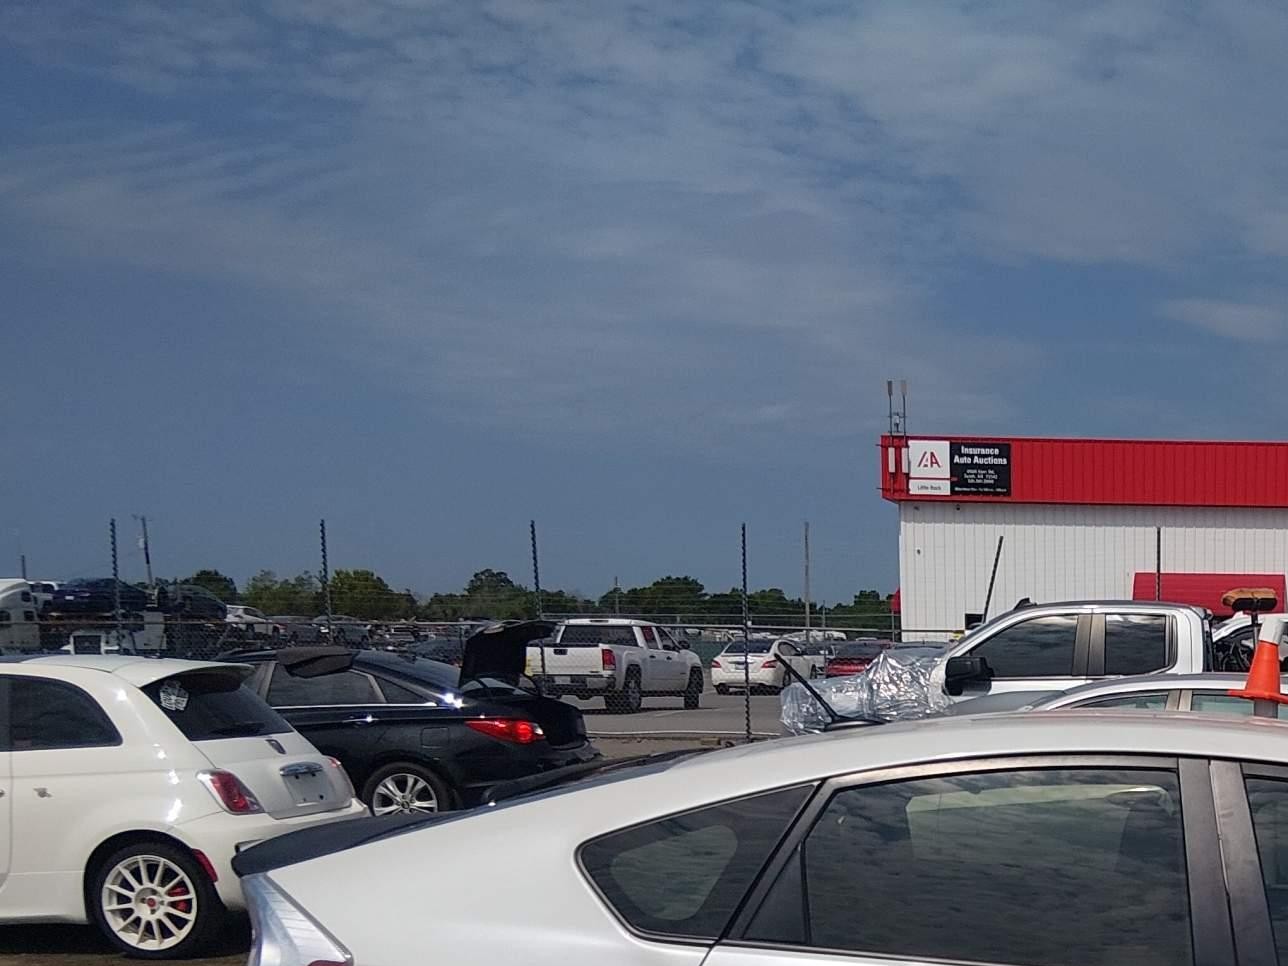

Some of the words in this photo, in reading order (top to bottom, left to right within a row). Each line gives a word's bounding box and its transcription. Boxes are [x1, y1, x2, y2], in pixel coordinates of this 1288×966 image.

[961, 445, 999, 455] Insurance
[953, 455, 972, 464] Auto
[973, 455, 1007, 465] Auctions
